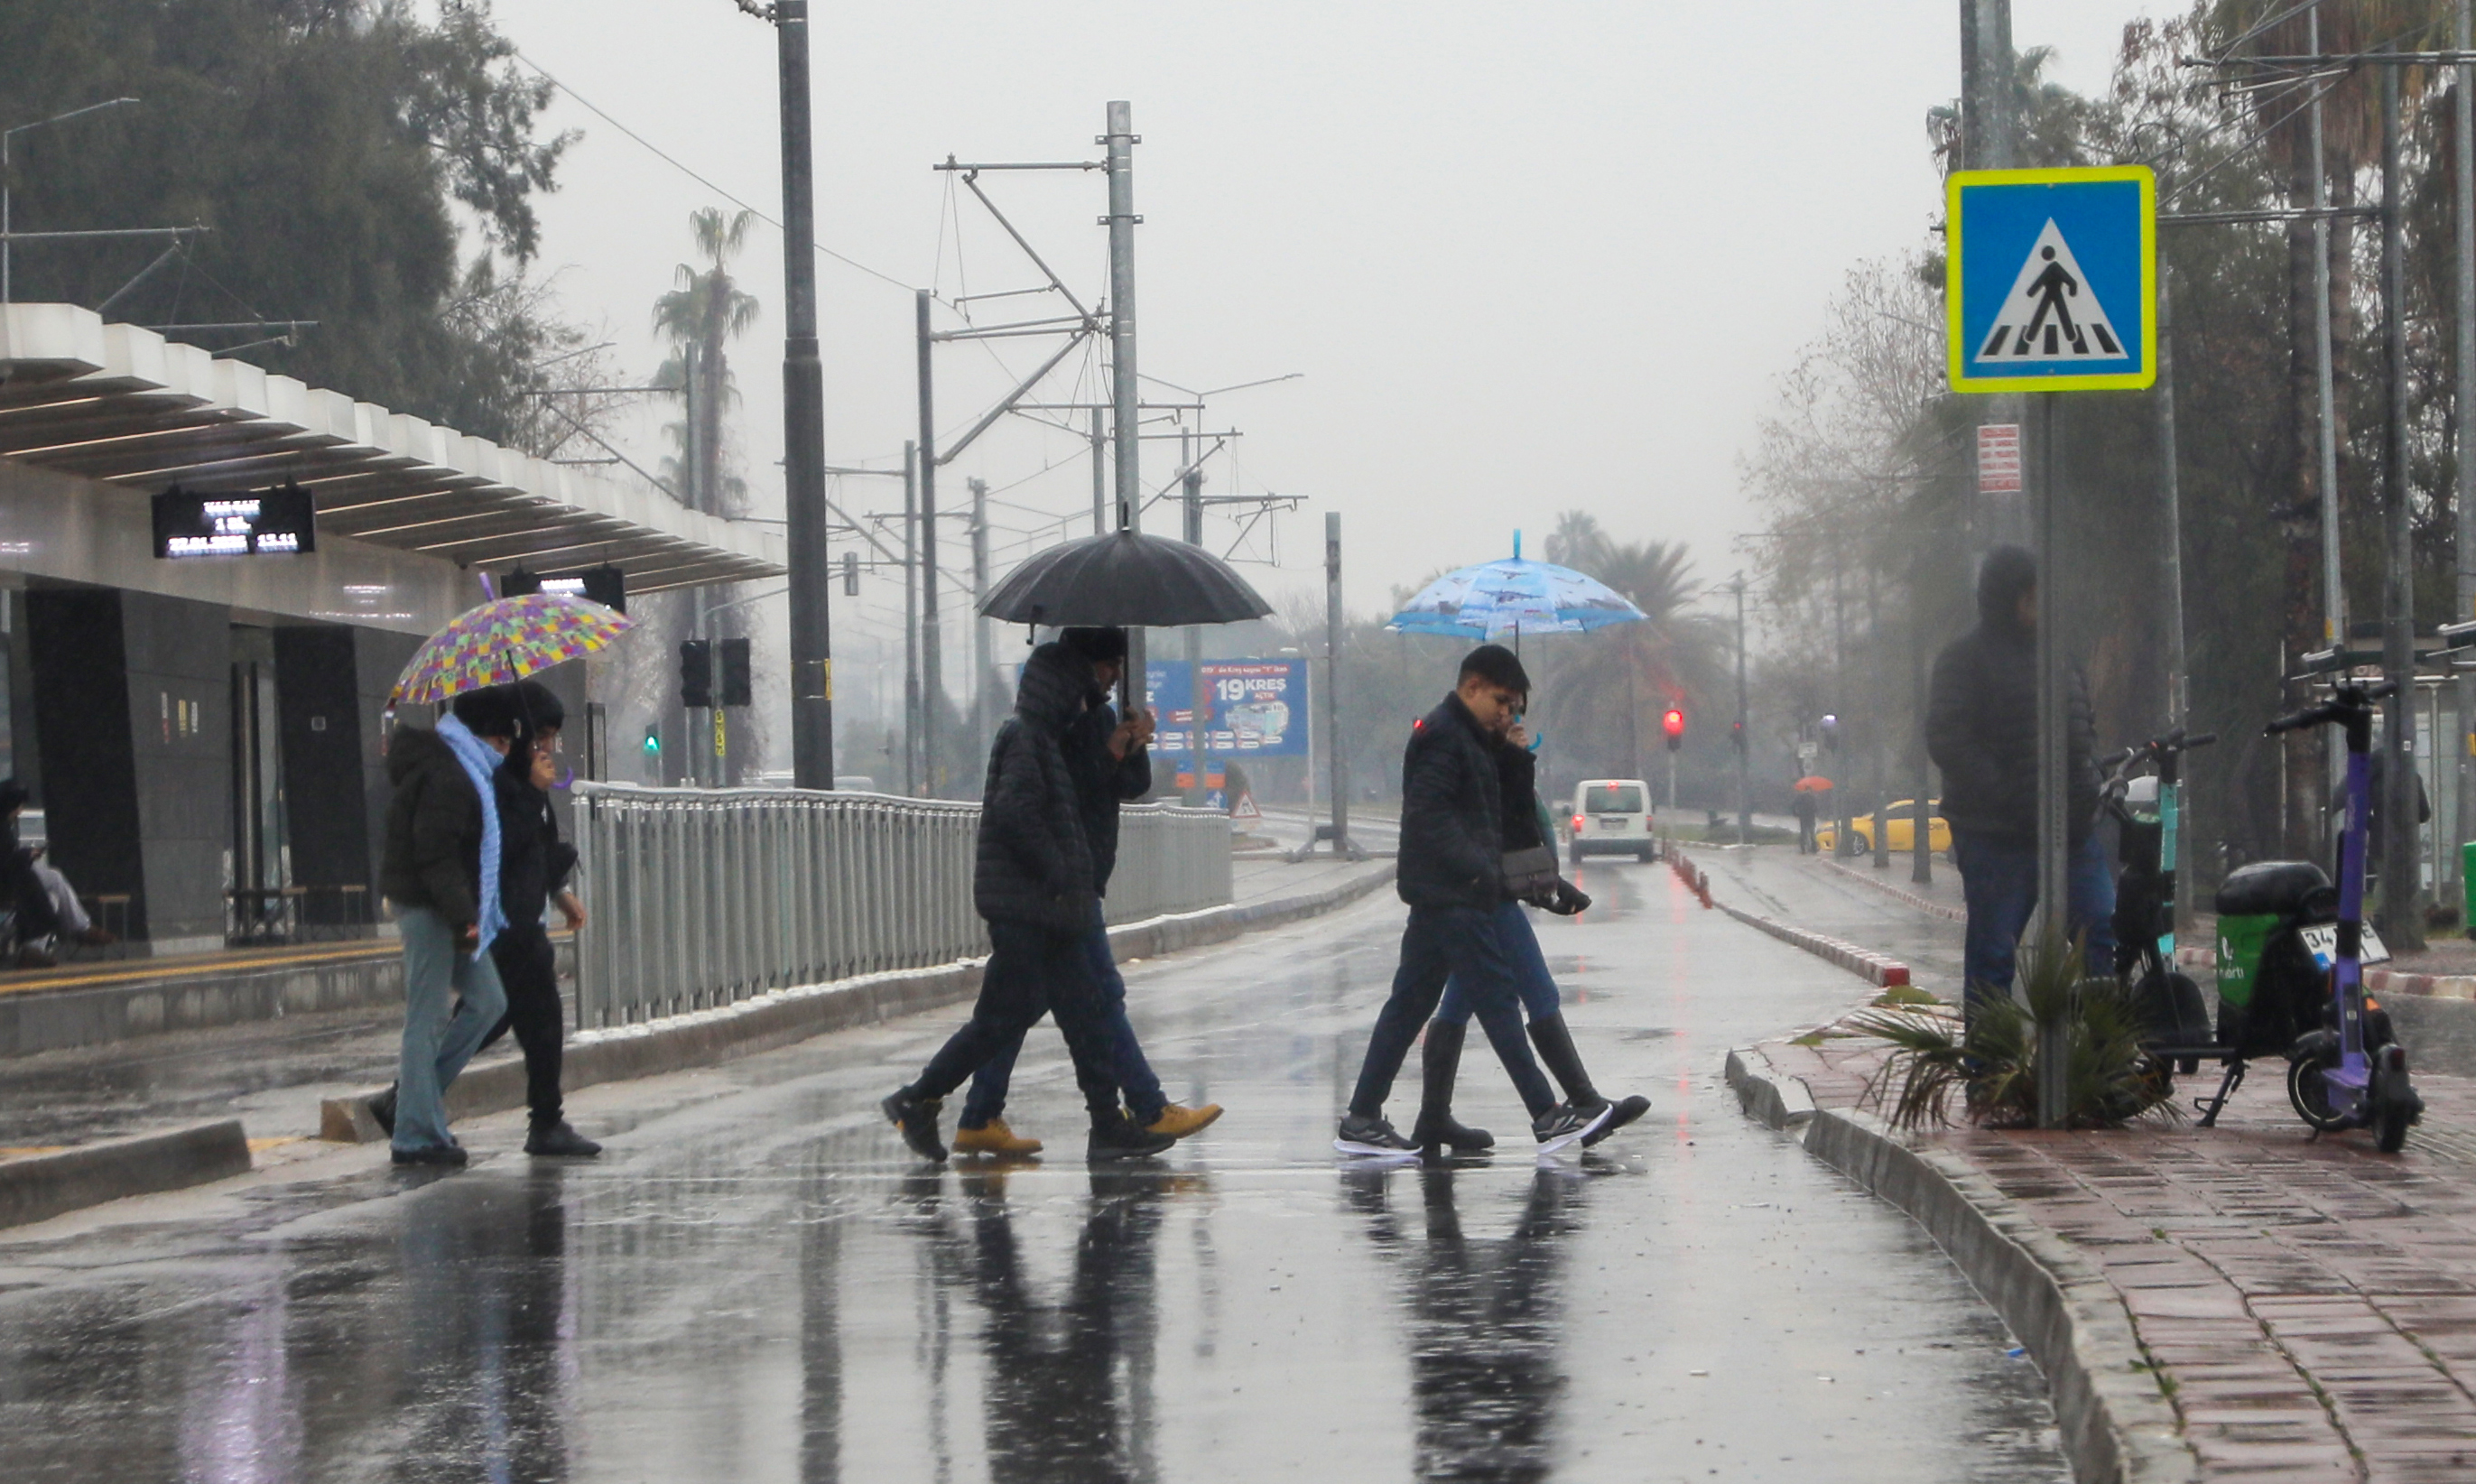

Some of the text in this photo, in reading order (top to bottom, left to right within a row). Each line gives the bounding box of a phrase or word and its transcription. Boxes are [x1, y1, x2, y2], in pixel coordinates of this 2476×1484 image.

[1217, 678, 1287, 700] 19 KREŞ
[2305, 931, 2333, 948] 34
